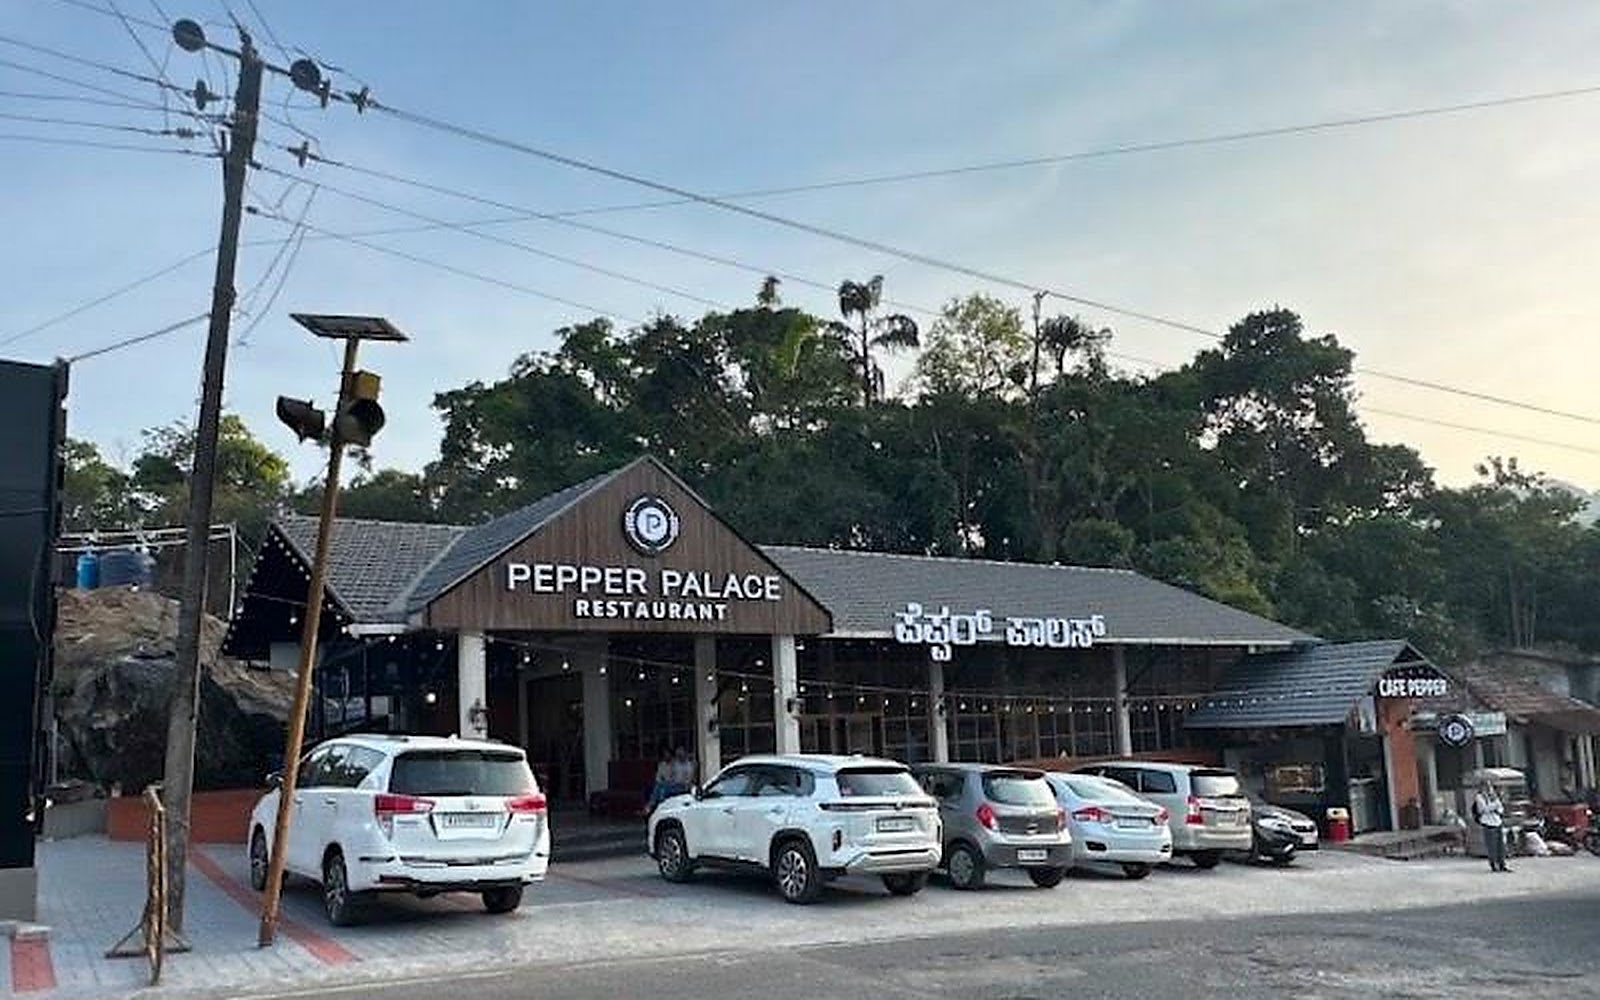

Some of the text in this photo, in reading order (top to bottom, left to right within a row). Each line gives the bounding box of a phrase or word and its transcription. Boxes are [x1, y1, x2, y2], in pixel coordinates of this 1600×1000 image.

[507, 563, 783, 600] PEPPER PALACE
[575, 600, 728, 620] RESTAURANT
[1379, 679, 1447, 696] CAFE PEPPER
